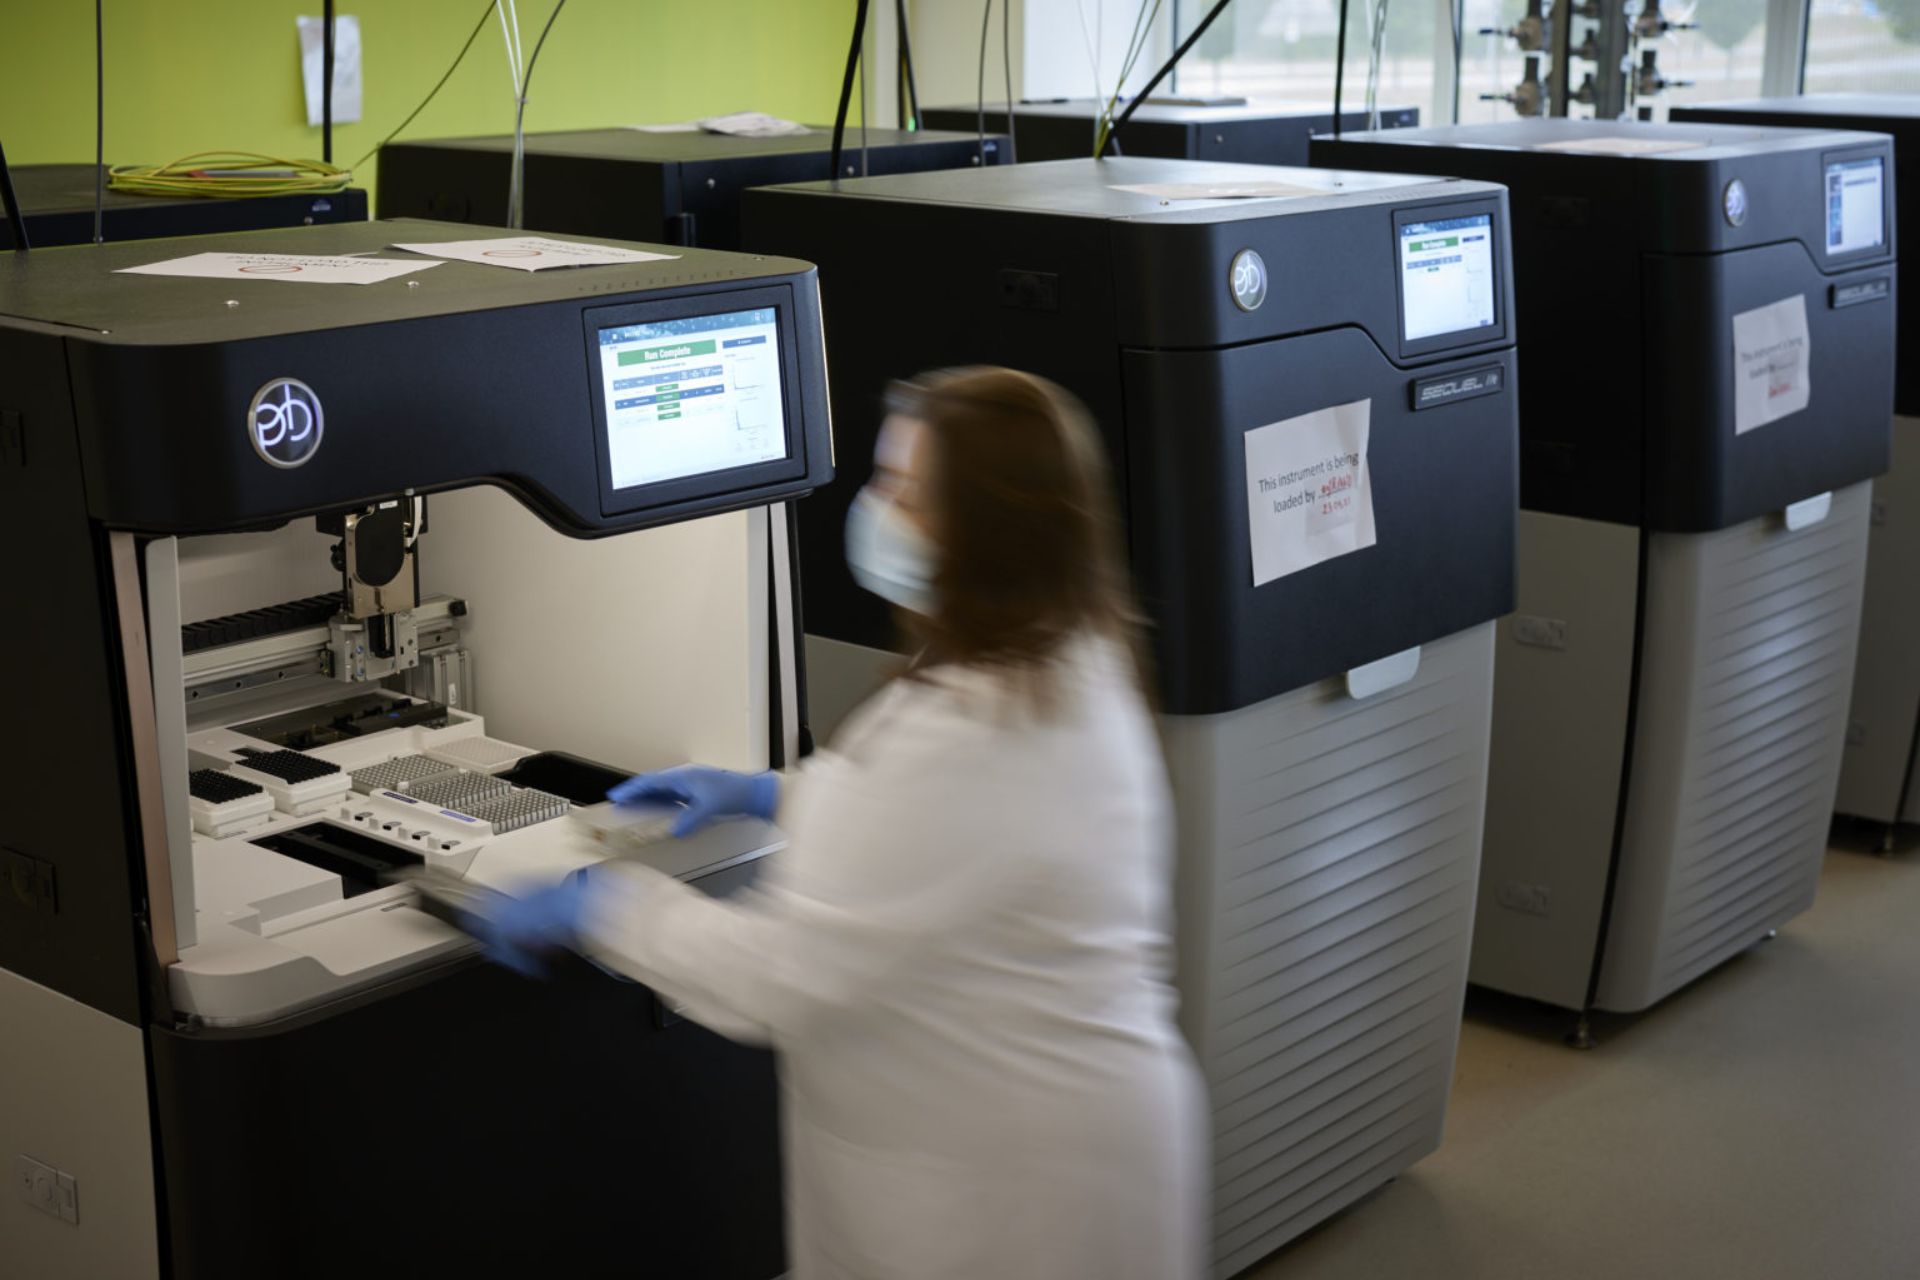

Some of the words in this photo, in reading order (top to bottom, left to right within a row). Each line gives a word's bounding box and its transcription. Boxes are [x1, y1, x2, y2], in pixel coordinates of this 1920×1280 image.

[644, 350, 658, 361] Run
[659, 346, 691, 359] Complete
[1258, 478, 1277, 493] This
[1279, 462, 1325, 485] instrument
[1327, 459, 1333, 471] is
[1334, 453, 1359, 468] being
[1273, 492, 1303, 513] loaded
[1304, 489, 1315, 504] by
